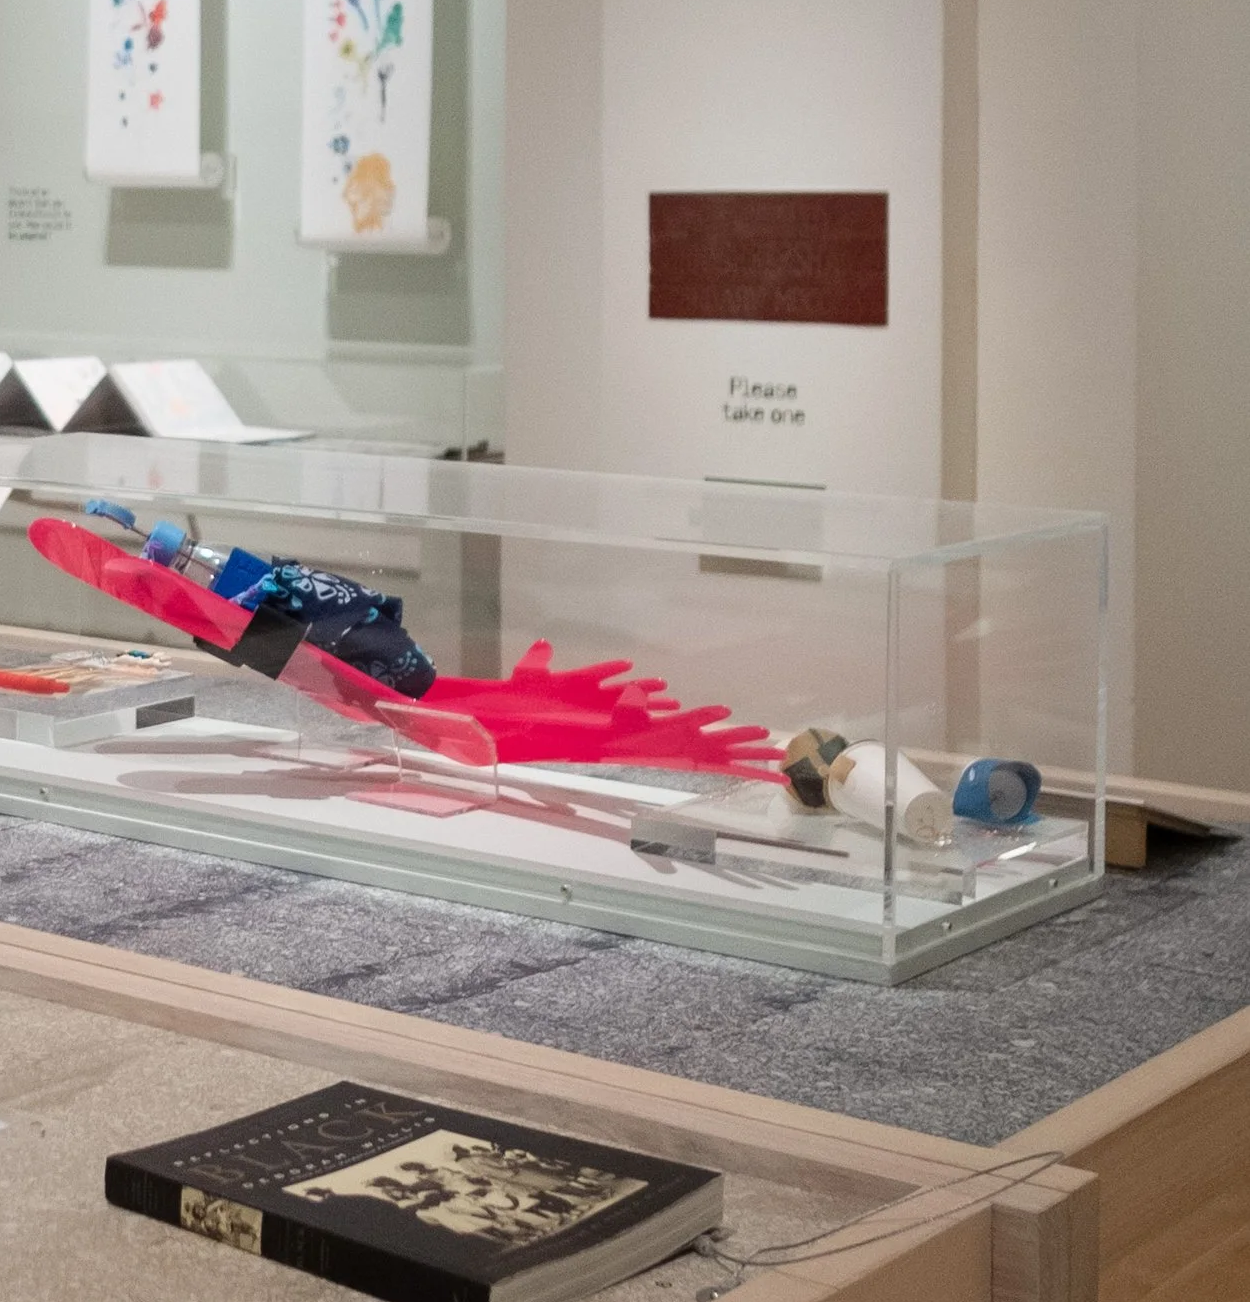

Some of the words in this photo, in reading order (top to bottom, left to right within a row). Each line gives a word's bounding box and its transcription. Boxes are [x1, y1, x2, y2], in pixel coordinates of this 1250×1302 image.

[730, 377, 797, 399] Please
[724, 403, 765, 423] take
[771, 408, 806, 426] one
[189, 1101, 428, 1184] BLACK
